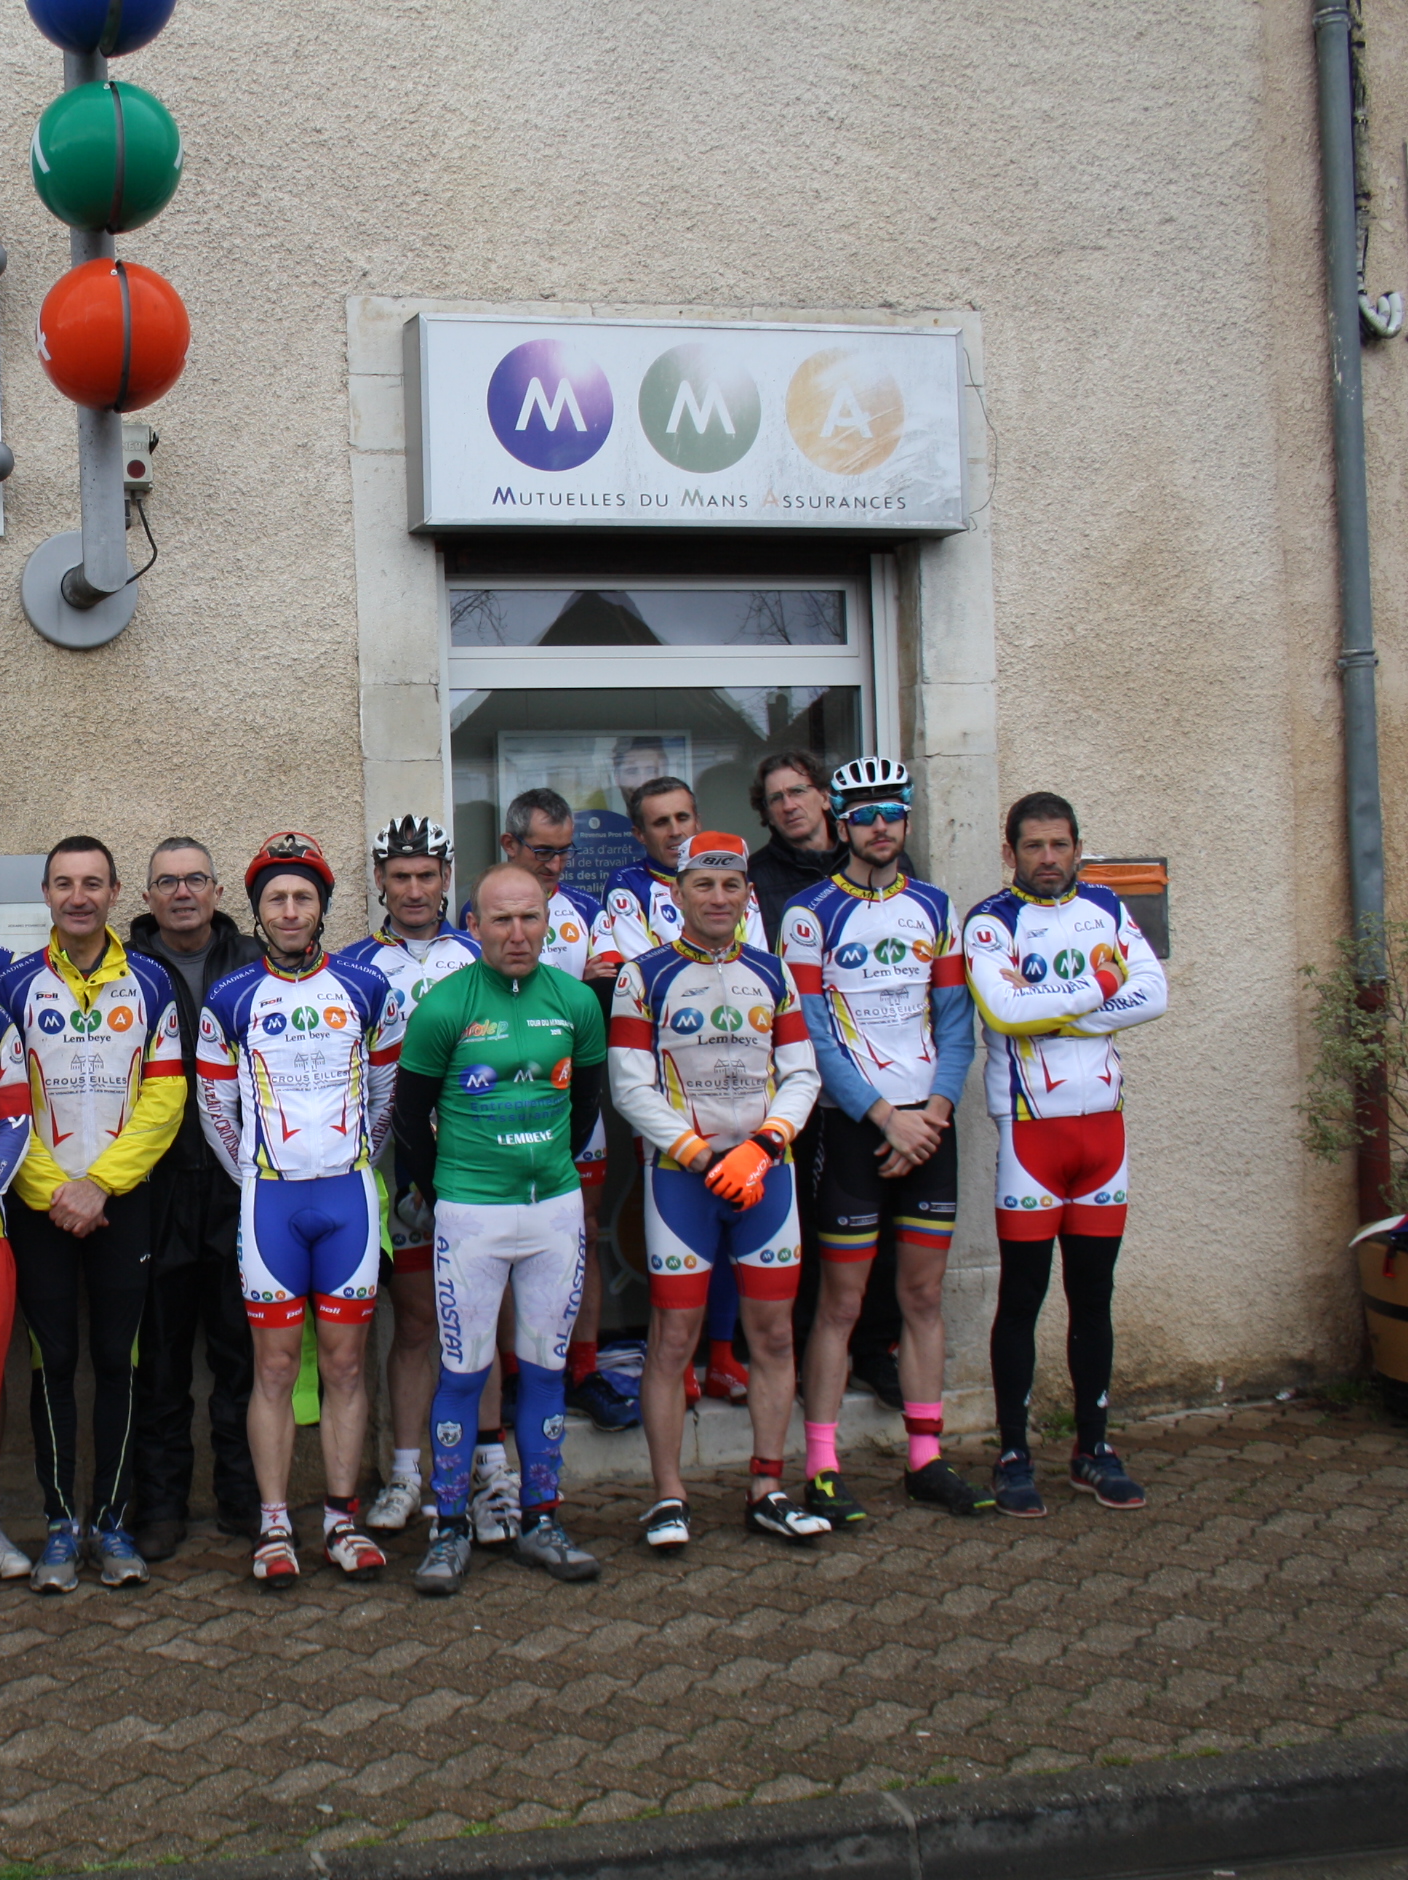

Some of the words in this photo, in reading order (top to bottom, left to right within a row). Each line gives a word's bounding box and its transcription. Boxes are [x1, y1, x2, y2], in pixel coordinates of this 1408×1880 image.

[515, 377, 587, 432] M
[666, 380, 735, 434] M
[820, 387, 872, 438] A
[492, 487, 626, 508] MUTUELLES
[640, 493, 669, 508] DU
[598, 845, 632, 854] d'arrêt
[581, 858, 592, 867] de
[576, 870, 597, 880] des
[209, 968, 255, 1000] C.C.MADIRAN
[45, 1076, 127, 1085] CROUSEILLES
